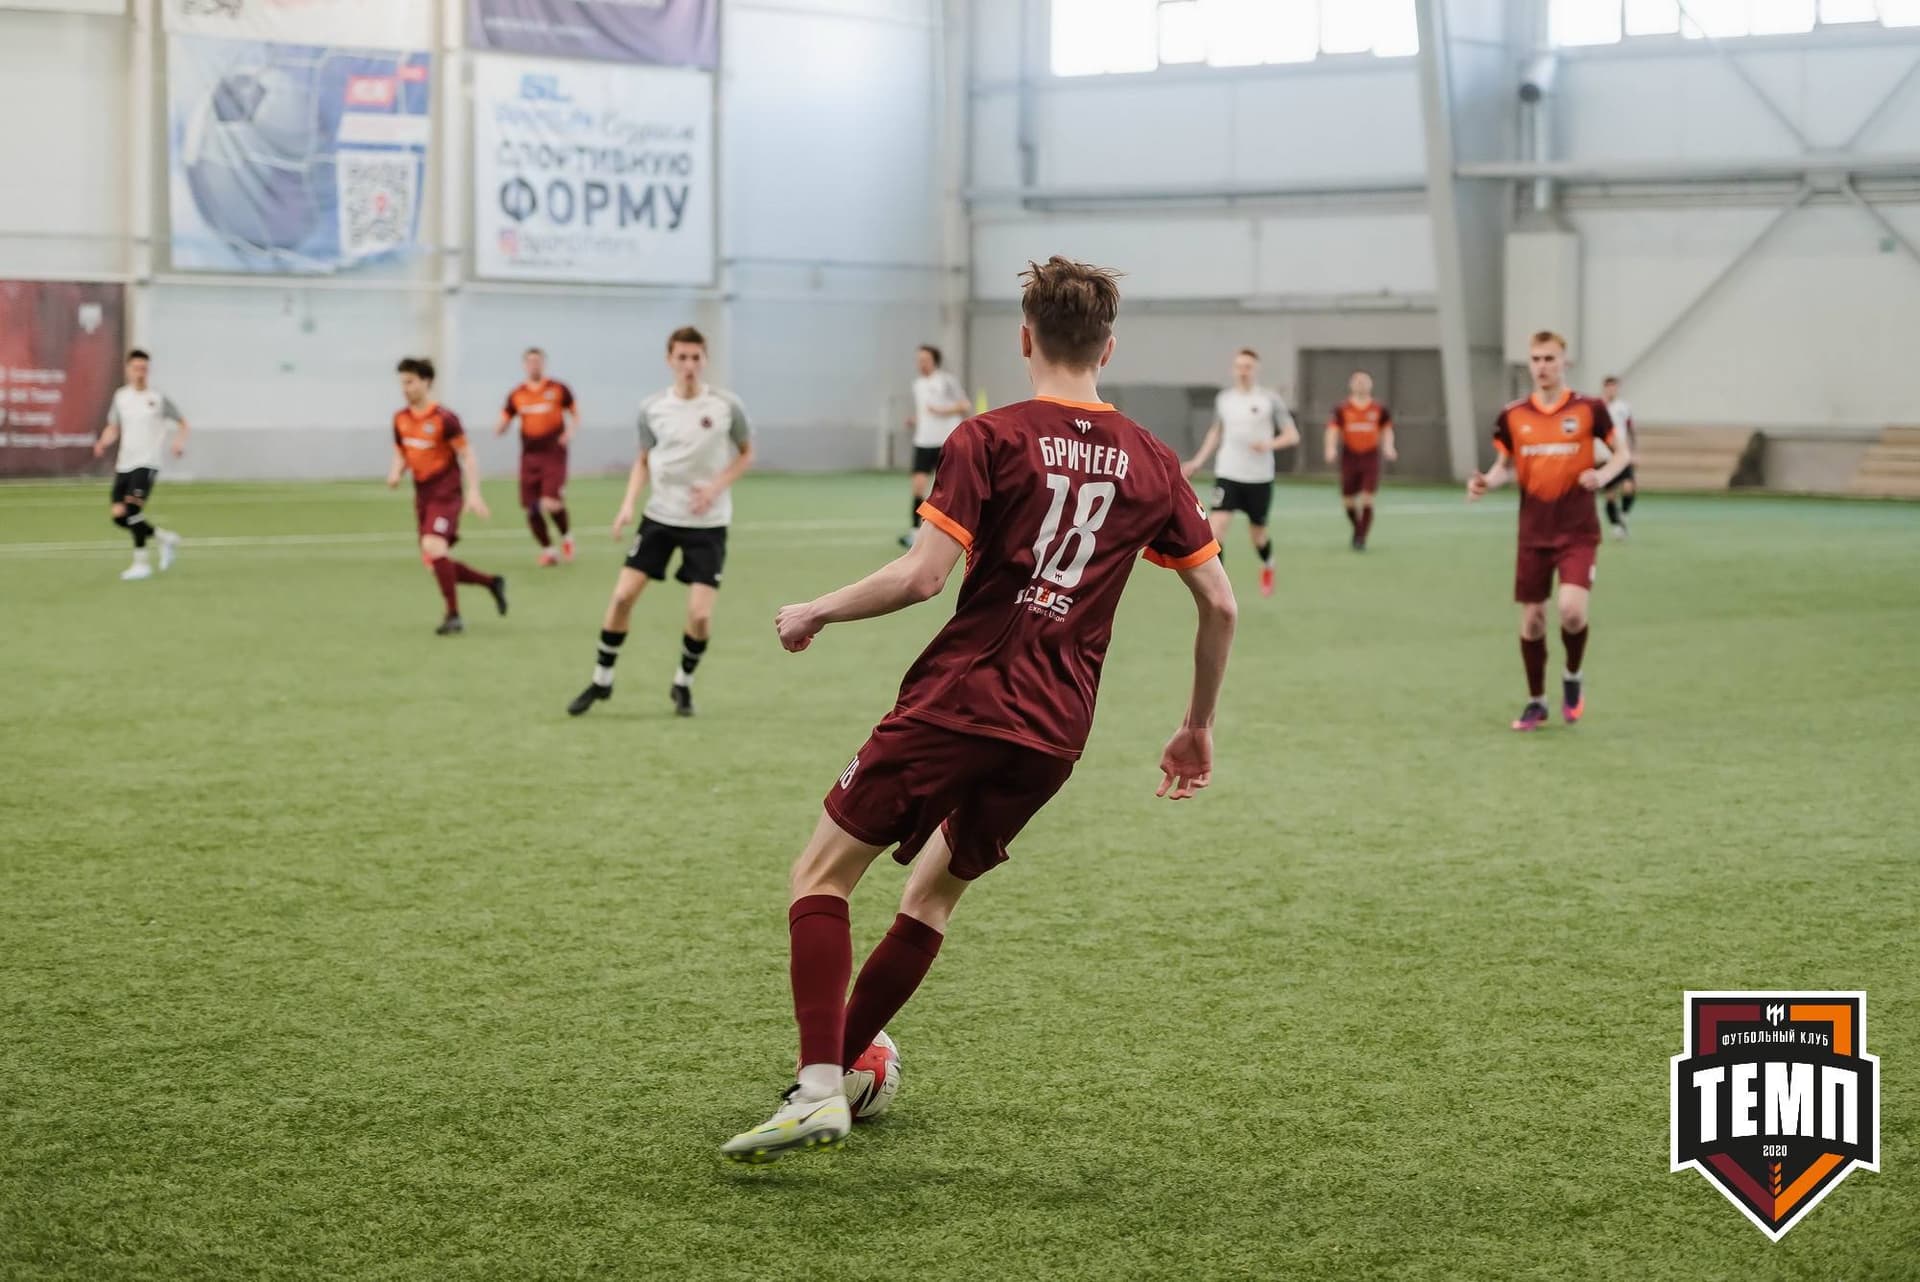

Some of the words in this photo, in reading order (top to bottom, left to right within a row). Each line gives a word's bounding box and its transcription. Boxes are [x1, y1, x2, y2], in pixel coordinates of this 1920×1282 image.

[499, 176, 689, 231] ФОРМУ
[1038, 436, 1129, 480] БРИЧЕЕВ
[1031, 473, 1116, 588] 18
